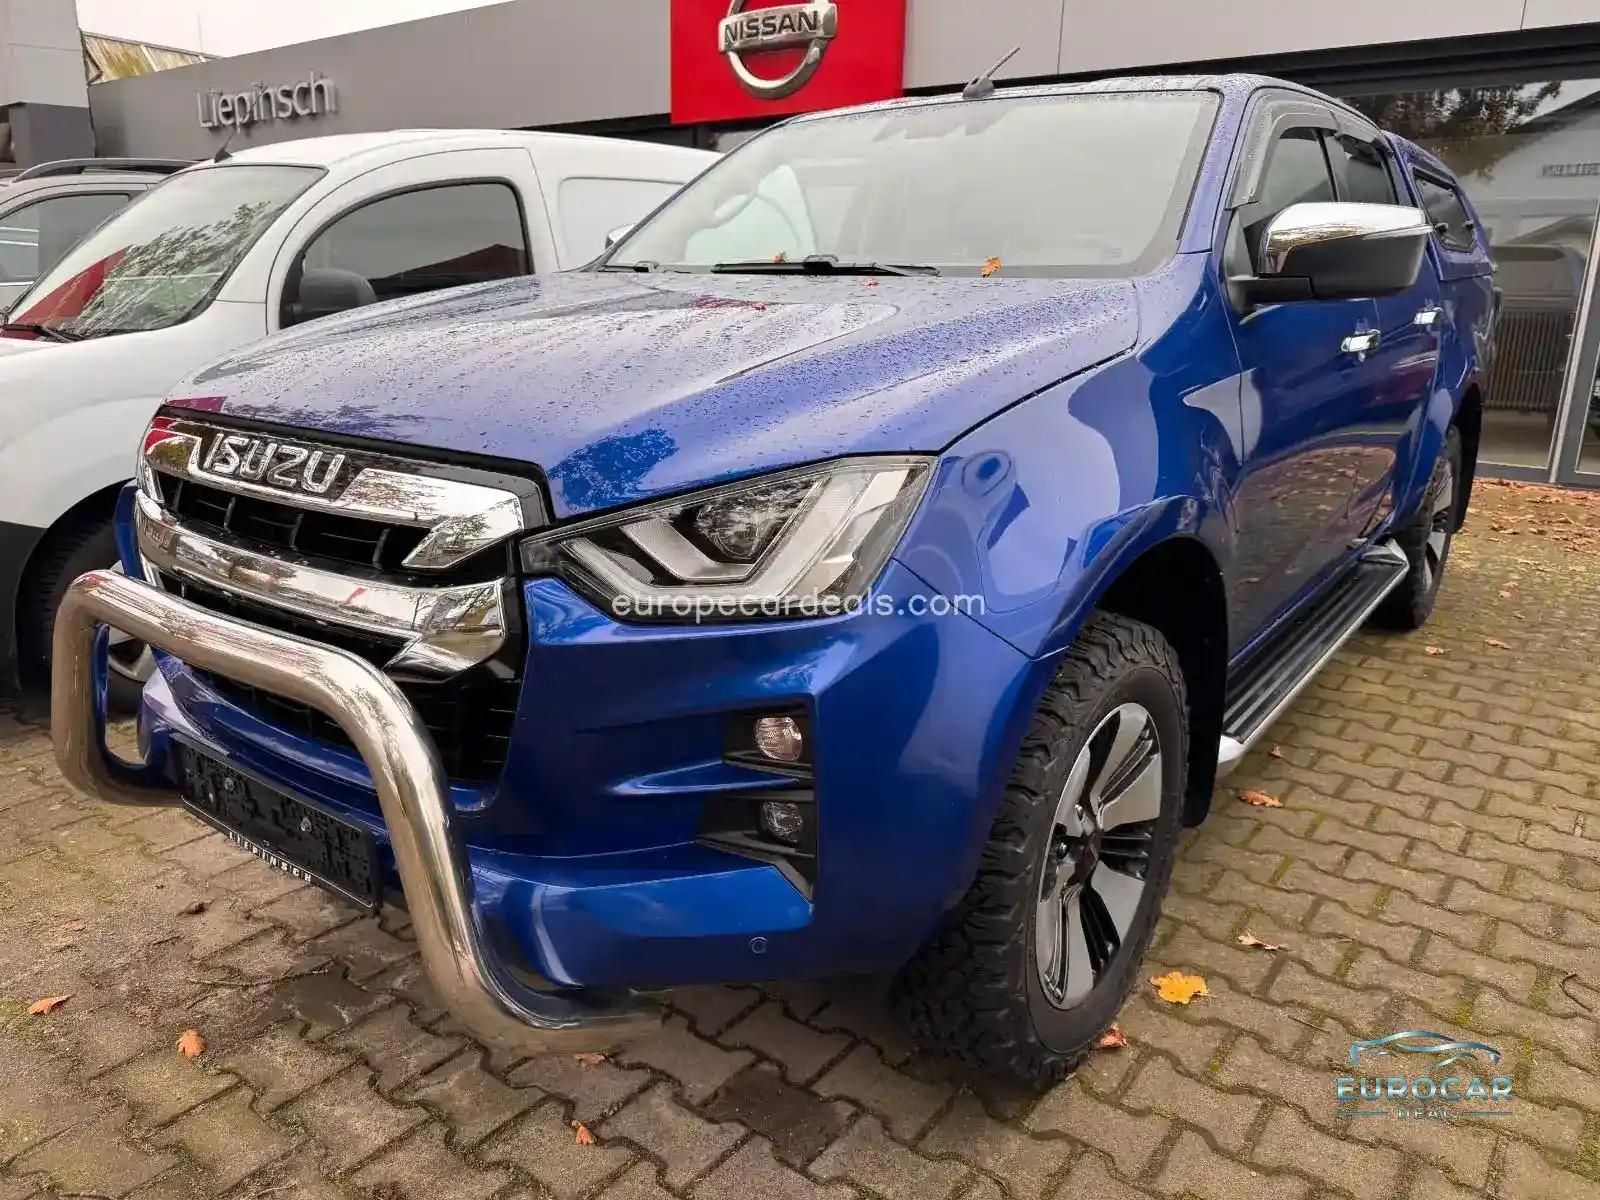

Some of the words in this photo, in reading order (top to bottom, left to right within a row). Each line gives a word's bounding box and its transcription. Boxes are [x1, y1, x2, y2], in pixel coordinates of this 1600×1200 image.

[724, 10, 818, 45] NISSAN
[197, 70, 335, 134] Liepinsch
[203, 433, 346, 494] ISUZU
[229, 831, 312, 883] LIEPINSCH
